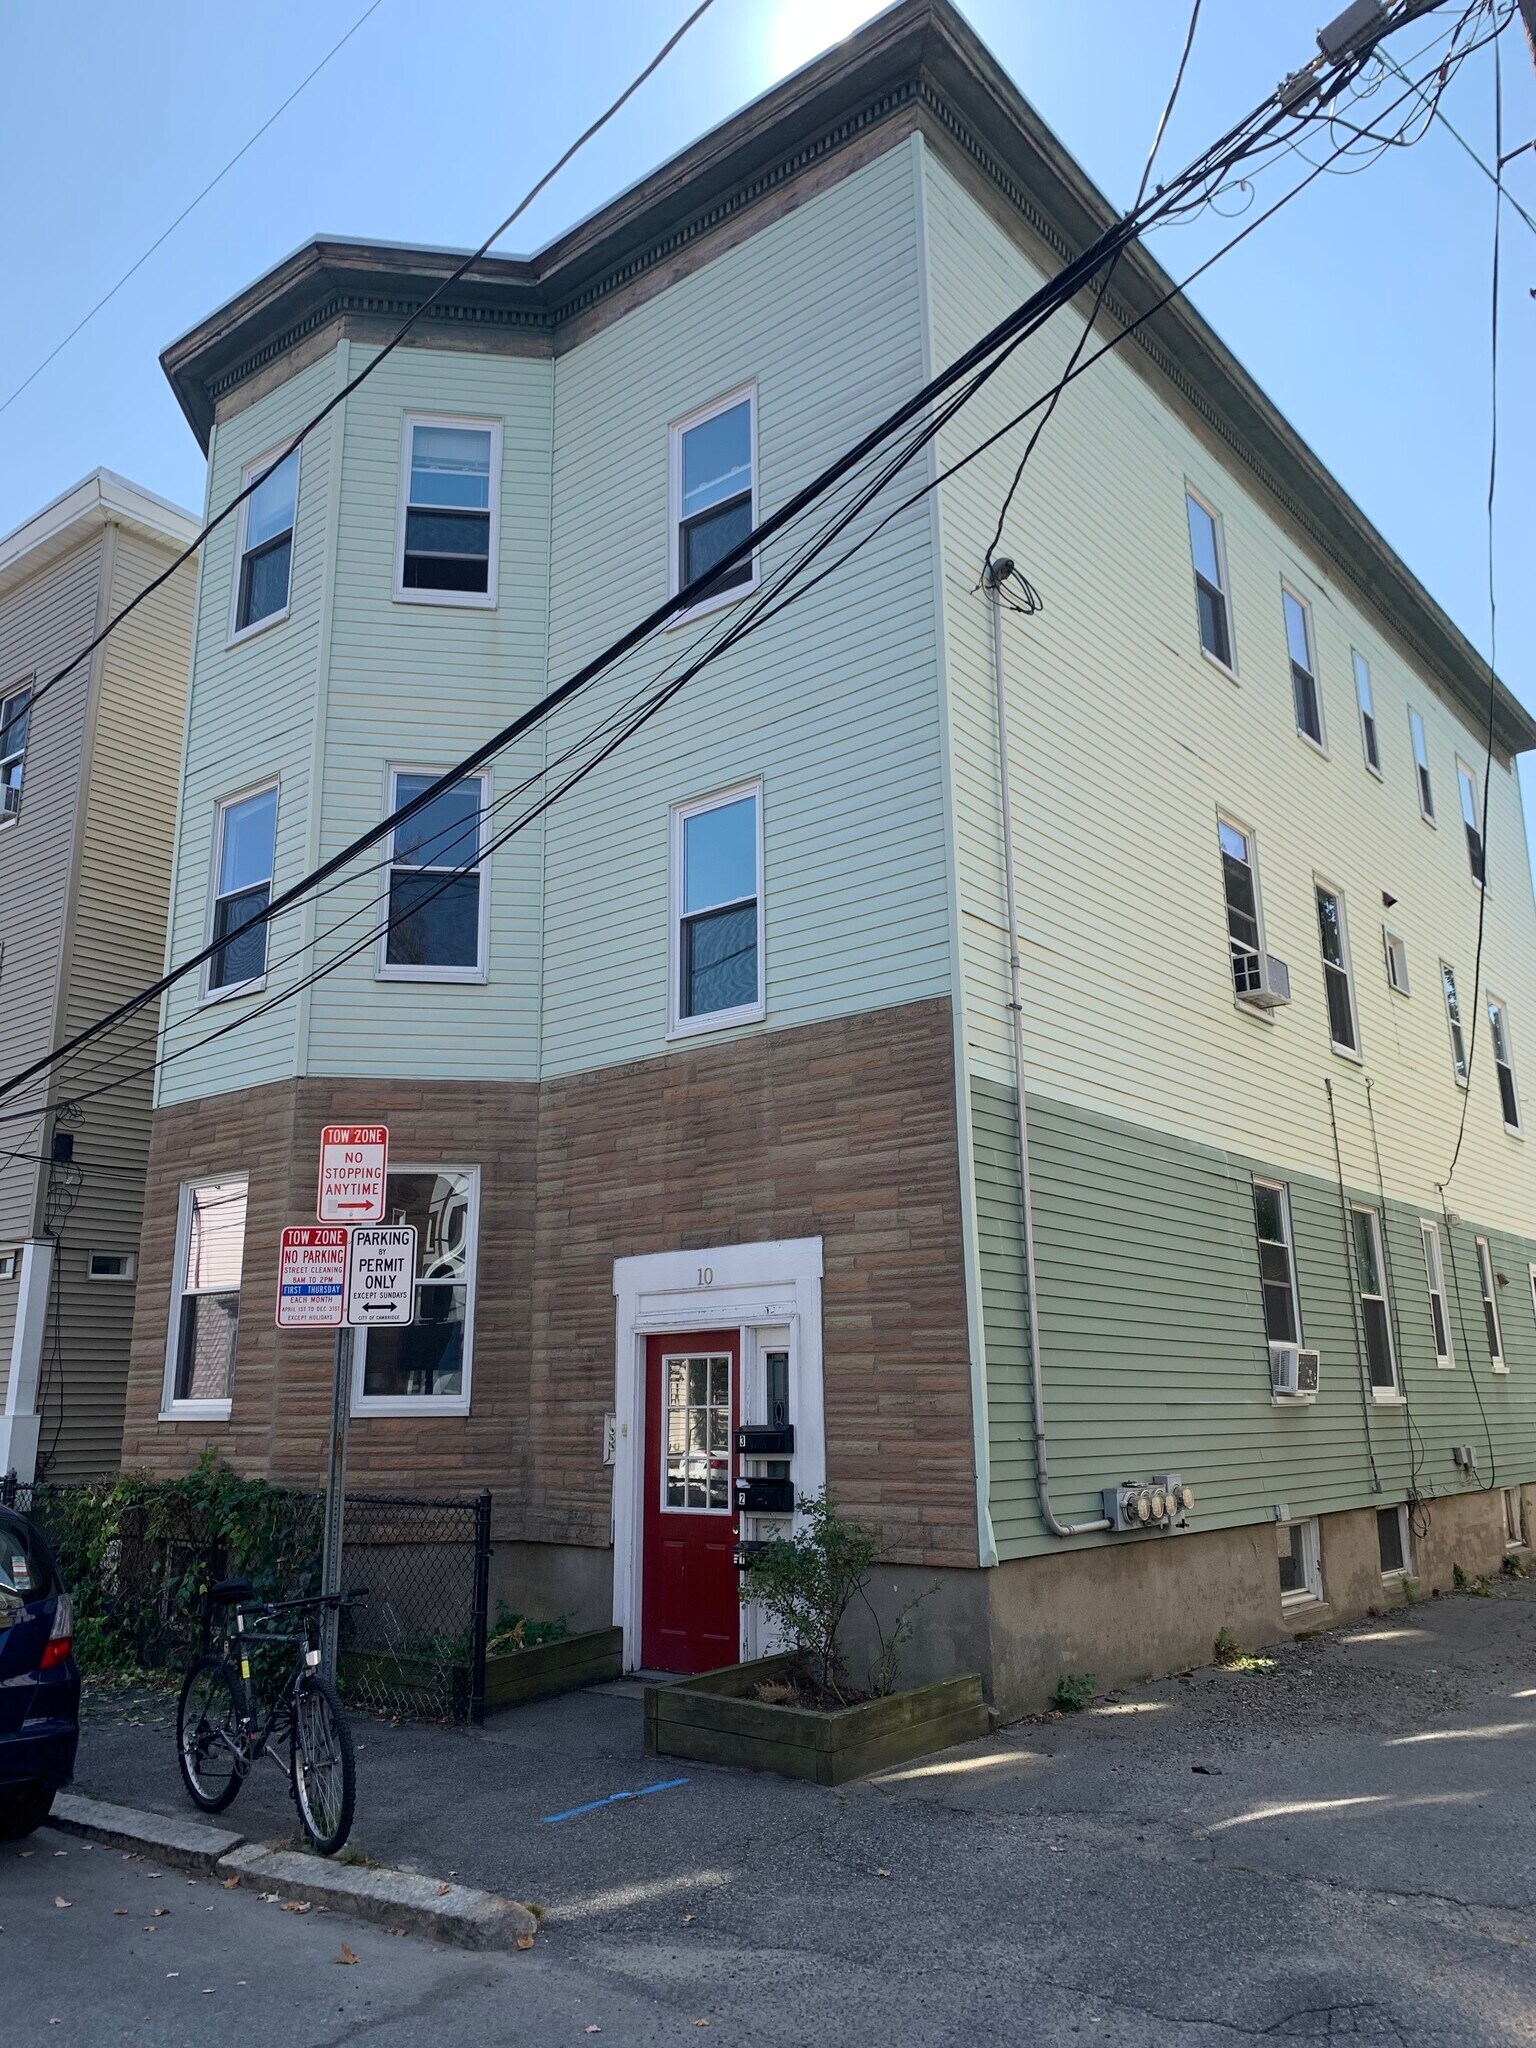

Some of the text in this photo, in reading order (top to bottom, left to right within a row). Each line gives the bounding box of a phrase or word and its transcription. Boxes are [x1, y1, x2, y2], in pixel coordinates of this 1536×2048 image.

[328, 1130, 382, 1143] TOW ZONE
[345, 1152, 363, 1163] NO
[326, 1168, 381, 1179] STOPPING
[326, 1183, 379, 1195] ANYTIME
[288, 1230, 343, 1244] TOW ZONE
[357, 1232, 409, 1246] PARKING
[285, 1250, 343, 1264] NO PARKING
[359, 1258, 404, 1272] PERMIT
[365, 1275, 397, 1289] ONLY
[697, 1268, 713, 1285] 10
[284, 1285, 340, 1294] FIRST THURSDAY
[740, 1436, 745, 1446] 3
[740, 1494, 745, 1504] 2
